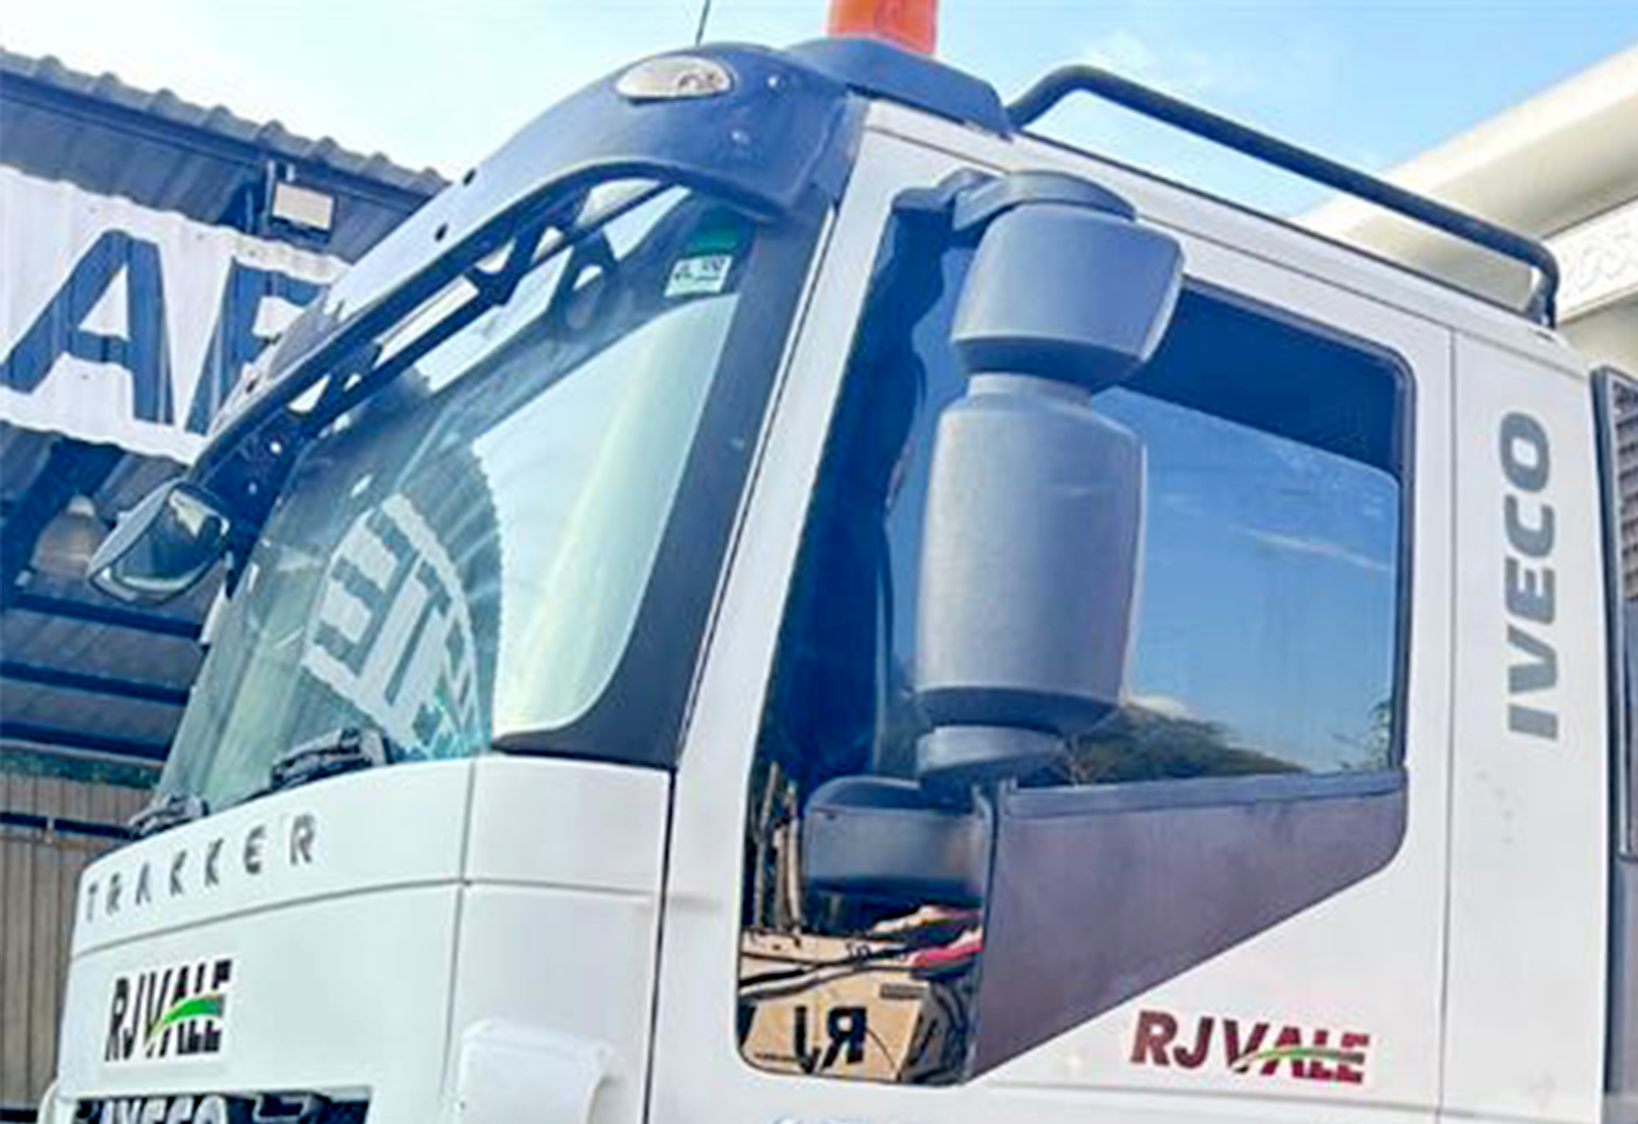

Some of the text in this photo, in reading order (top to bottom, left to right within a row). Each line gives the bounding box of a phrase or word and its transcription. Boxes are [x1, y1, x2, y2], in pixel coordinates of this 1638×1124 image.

[1499, 411, 1559, 740] IVECO
[86, 814, 318, 923] TRAKKER
[104, 959, 233, 1063] RJVALE
[1130, 1009, 1370, 1086] RJVALE
